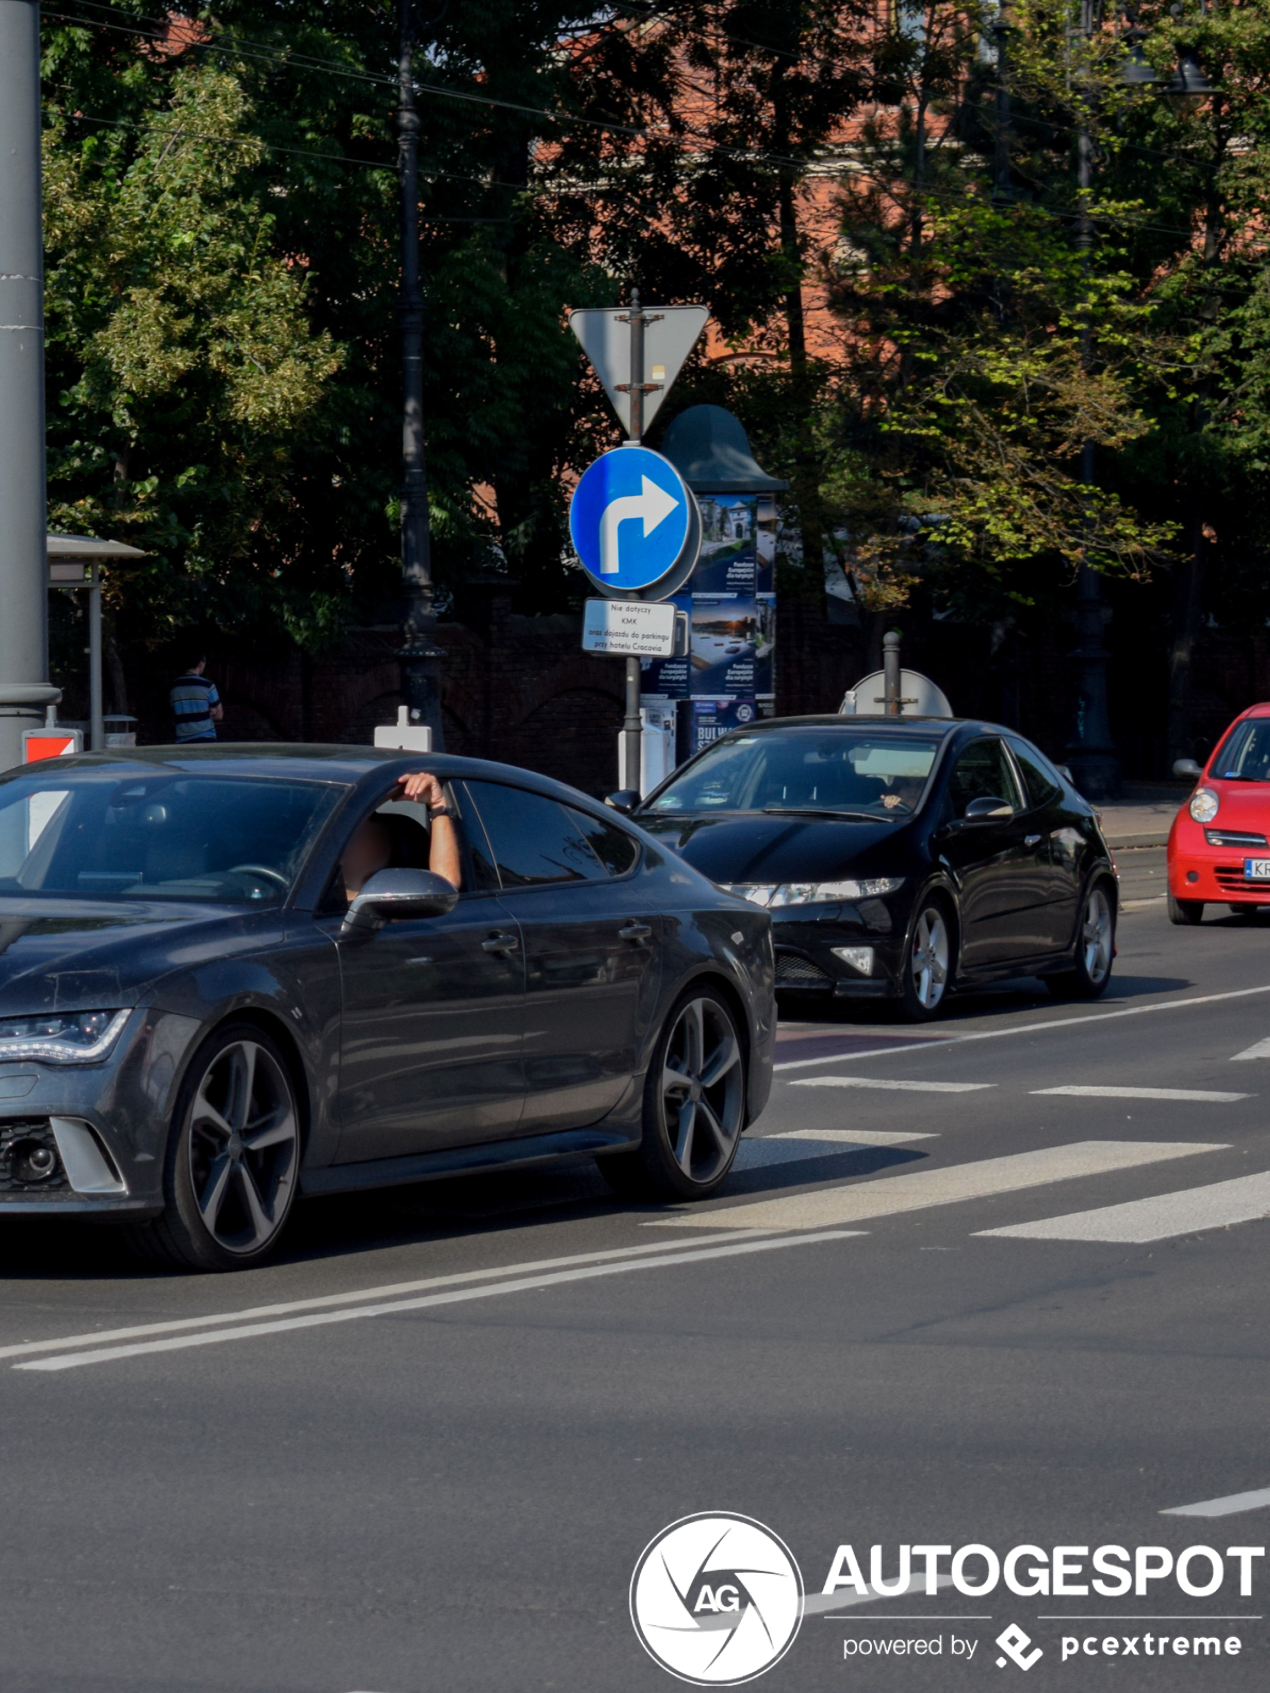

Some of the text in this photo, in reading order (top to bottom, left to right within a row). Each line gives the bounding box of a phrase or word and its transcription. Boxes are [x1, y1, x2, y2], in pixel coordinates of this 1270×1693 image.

[610, 604, 651, 614] Nie dotyczy
[621, 617, 638, 625] KMK
[604, 629, 629, 639] dojazdu
[631, 631, 640, 639] do
[641, 632, 669, 642] parkingu
[594, 641, 662, 652] przy hotelu Cracovia
